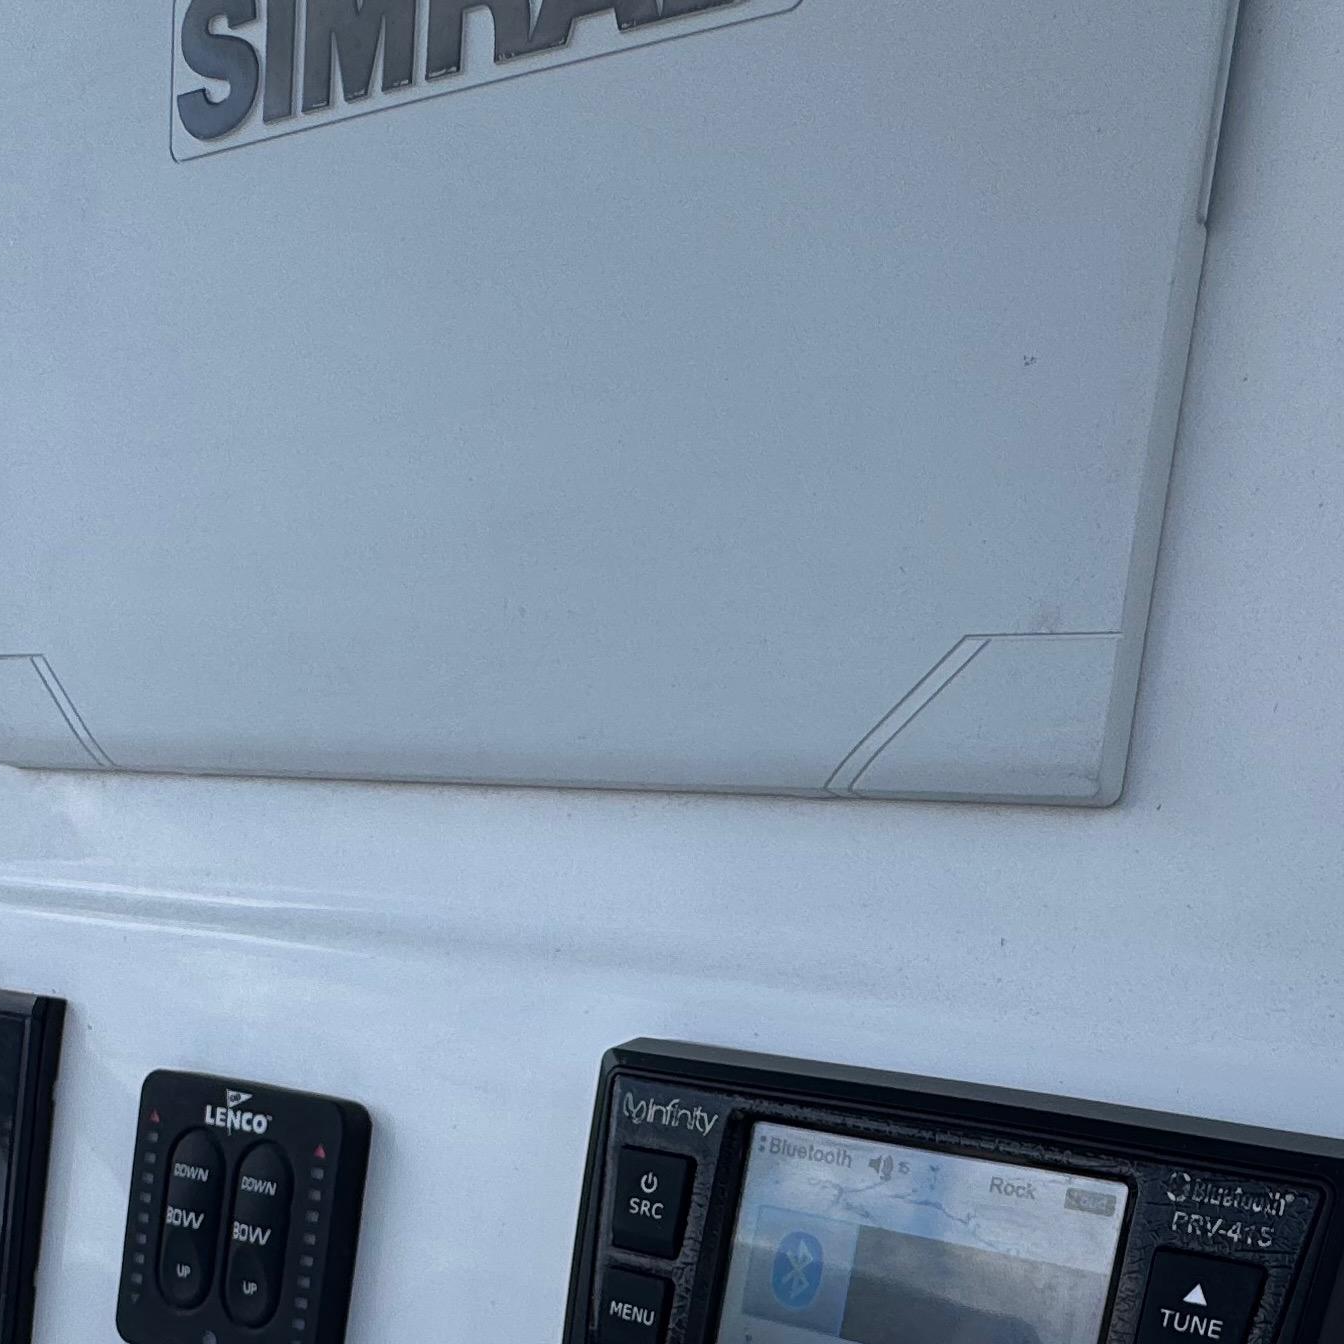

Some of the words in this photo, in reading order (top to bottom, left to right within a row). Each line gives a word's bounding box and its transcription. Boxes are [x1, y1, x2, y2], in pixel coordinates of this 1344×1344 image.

[205, 1104, 268, 1135] LENCO
[769, 1136, 852, 1169] Bluetooth
[174, 1163, 209, 1182] DOWN
[241, 1176, 276, 1196] DOWN
[989, 1176, 1036, 1201] Rock
[166, 1205, 205, 1230] BOW
[629, 1197, 665, 1220] SRC
[232, 1221, 272, 1246] BOW
[177, 1263, 191, 1278] UP
[243, 1281, 257, 1296] UP
[609, 1300, 655, 1327] MENU
[1160, 1308, 1224, 1340] TUNE
